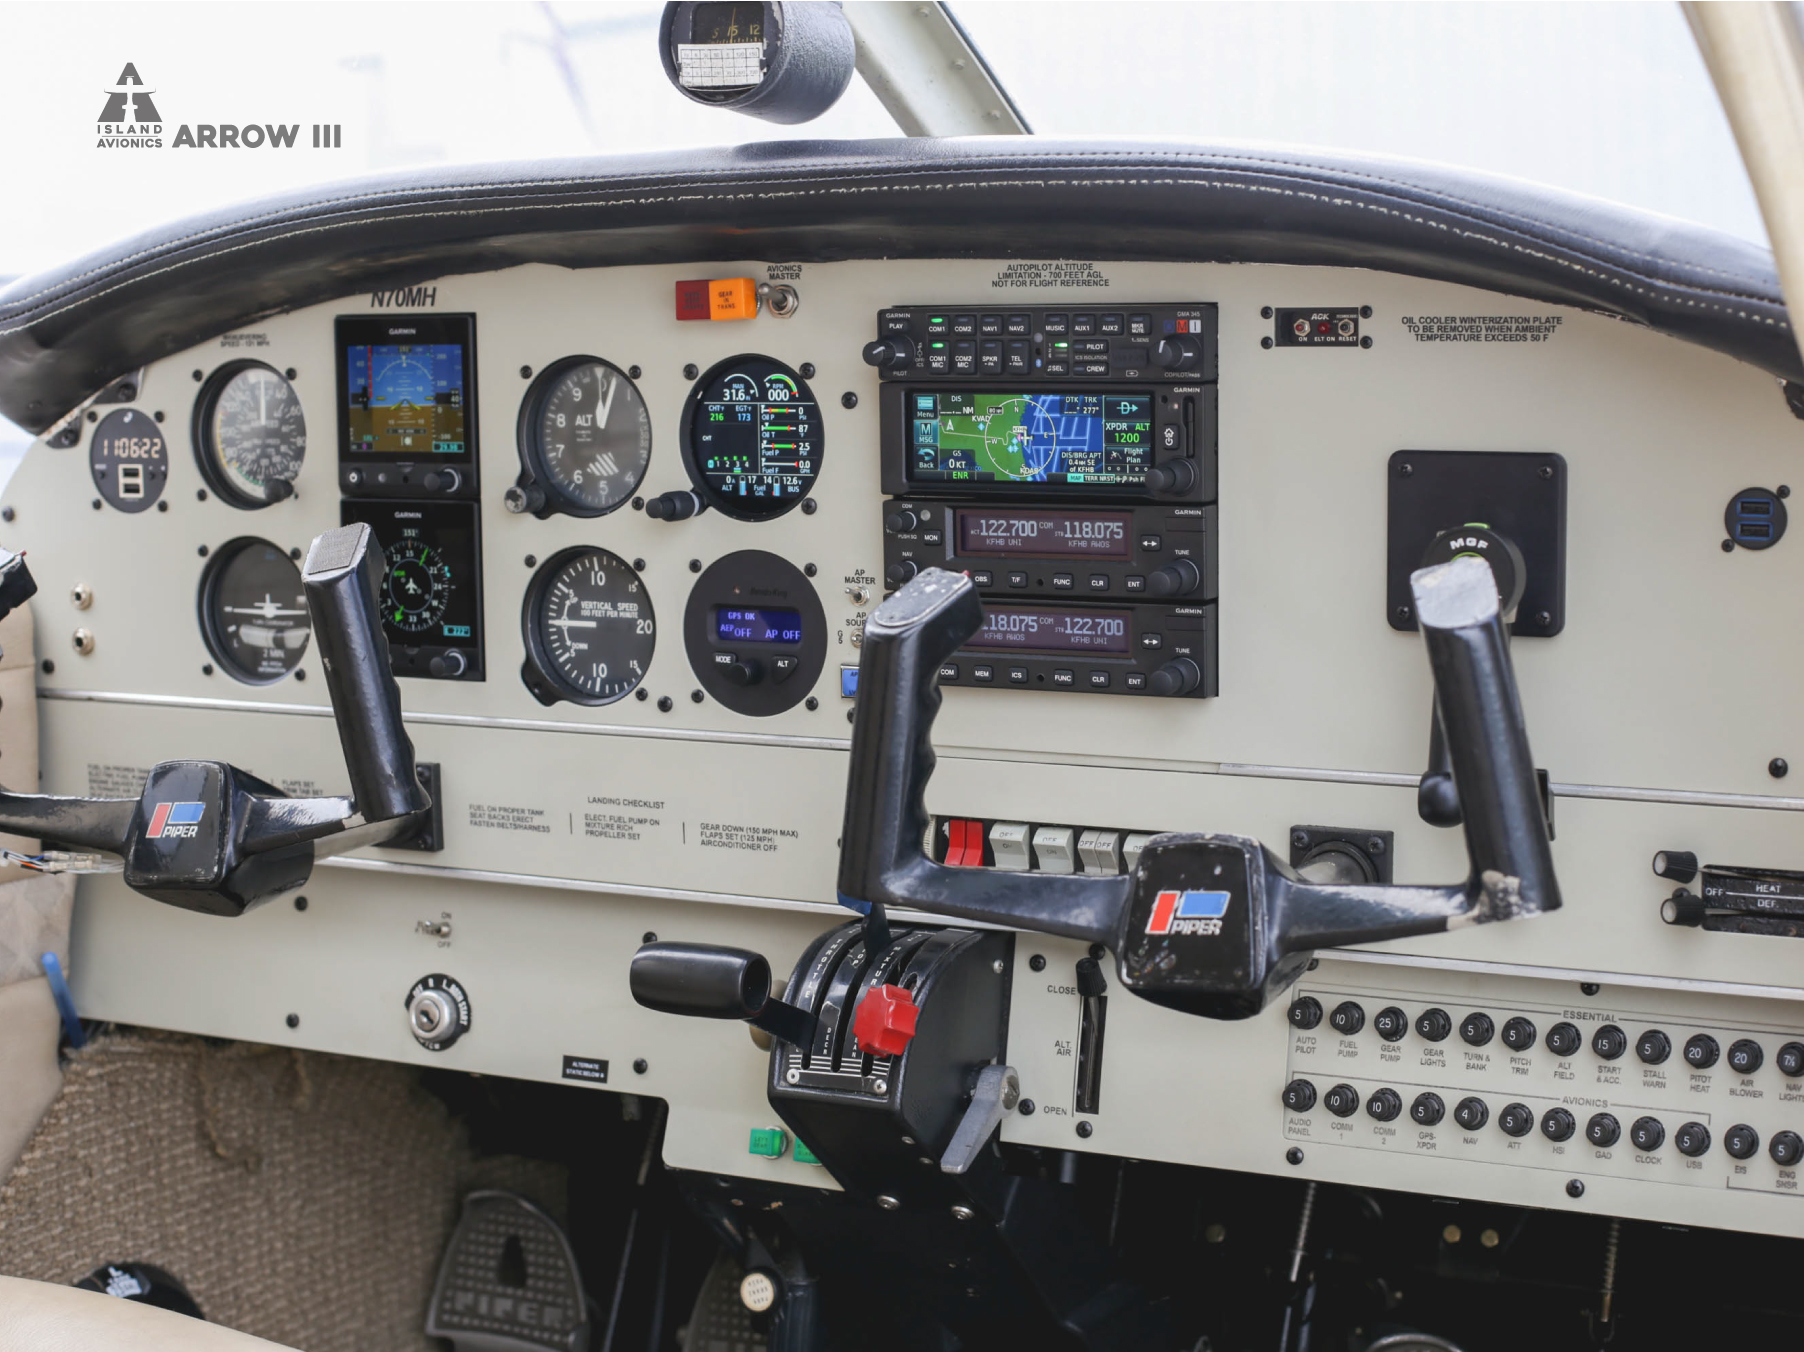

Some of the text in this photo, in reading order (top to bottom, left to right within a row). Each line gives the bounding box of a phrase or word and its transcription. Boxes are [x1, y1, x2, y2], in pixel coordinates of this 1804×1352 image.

[750, 25, 760, 35] 12
[1007, 263, 1093, 271] AUTOPILOT ALTITUDE
[1060, 279, 1109, 287] REFERENCE
[371, 287, 436, 308] N70MH
[1402, 316, 1562, 325] OIL COOLER WINTERIZATION PLATE
[1408, 325, 1556, 333] TO BE REMOVED WHEN AMBIENT
[1415, 334, 1549, 342] TEMPERATURE EXCEEDS 50 F
[572, 388, 582, 401] 9
[723, 389, 746, 401] 31.6
[768, 389, 789, 401] 000
[556, 413, 566, 428] 8
[575, 414, 593, 426] ALT
[710, 413, 724, 421] 216
[1105, 423, 1128, 431] XPDR
[1135, 423, 1150, 431] ALT
[1114, 433, 1140, 443] 1200
[556, 444, 565, 458] 7
[573, 470, 583, 484] 6
[980, 520, 1037, 537] 122.700
[1064, 521, 1123, 539] 118.075
[591, 571, 606, 586] 10
[845, 576, 876, 585] MASTER
[581, 601, 638, 611] VERTICAL SPEED
[728, 612, 741, 620] GPS
[636, 619, 653, 634] 20
[1064, 617, 1124, 636] 122.700
[765, 629, 800, 640] AP OFF
[593, 663, 607, 678] 10
[587, 797, 665, 809] LANDING CHECKLIST
[609, 815, 660, 826] FUEL PUMP ON
[162, 825, 198, 838] PIPER
[585, 822, 633, 832] MIXTURE RICH
[700, 822, 778, 836] GEAR DOWN MPH
[585, 830, 641, 841] PROPELLER SET
[700, 831, 739, 841] FLAPS SET
[700, 840, 778, 852] AIRCONDITIONER OFF
[1705, 888, 1724, 896] OFF
[1756, 884, 1781, 893] HEAT
[1757, 899, 1779, 908] DEF.
[1170, 918, 1223, 936] PIPER
[805, 938, 843, 998] THROTTLE
[1047, 985, 1076, 996] CLOSE
[1294, 1009, 1301, 1020] 5
[1336, 1014, 1346, 1025] 10
[1563, 1010, 1617, 1023] ESSENTIAL
[1379, 1018, 1392, 1028] 25
[1422, 1020, 1429, 1031] 5
[1296, 1036, 1317, 1045] AUTO
[1339, 1040, 1358, 1049] FUEL
[1598, 1039, 1609, 1050] 15
[1056, 1048, 1071, 1056] AIR
[1295, 1045, 1316, 1054] PILOT
[1381, 1044, 1402, 1053] GEAR
[1423, 1048, 1444, 1058] GEAR
[1688, 1047, 1702, 1058] 20
[1338, 1050, 1358, 1058] PUMP
[1380, 1054, 1401, 1063] PUMP
[1463, 1052, 1485, 1061] TURN
[1734, 1052, 1748, 1064] 20
[1420, 1058, 1446, 1068] LIGHTS
[1466, 1062, 1487, 1071] BANK
[1510, 1057, 1531, 1066] PITCH
[1511, 1067, 1529, 1076] TRIM
[1597, 1065, 1622, 1075] START
[1643, 1069, 1667, 1080] STALL
[1554, 1071, 1575, 1080] FIELD
[1690, 1074, 1712, 1083] PITOT
[1643, 1080, 1666, 1089] WARN
[1740, 1079, 1754, 1087] AIR
[1690, 1084, 1711, 1093] HEAT
[1729, 1088, 1764, 1098] BLOWER
[1330, 1095, 1340, 1106] 10
[1562, 1096, 1608, 1108] AVIONICS
[1043, 1105, 1067, 1116] OPEN
[1372, 1102, 1382, 1112] 10
[1289, 1117, 1312, 1126] AUDIO
[1331, 1122, 1353, 1131] COMM
[1288, 1127, 1311, 1136] PANEL
[1373, 1126, 1396, 1136] COMM
[1416, 1141, 1437, 1150] XPDR
[1507, 1141, 1522, 1149] ATT
[1595, 1151, 1612, 1160] GAD
[1635, 1155, 1662, 1165] CLOCK
[1686, 1160, 1703, 1170] USB
[1779, 1170, 1796, 1179] ENG
